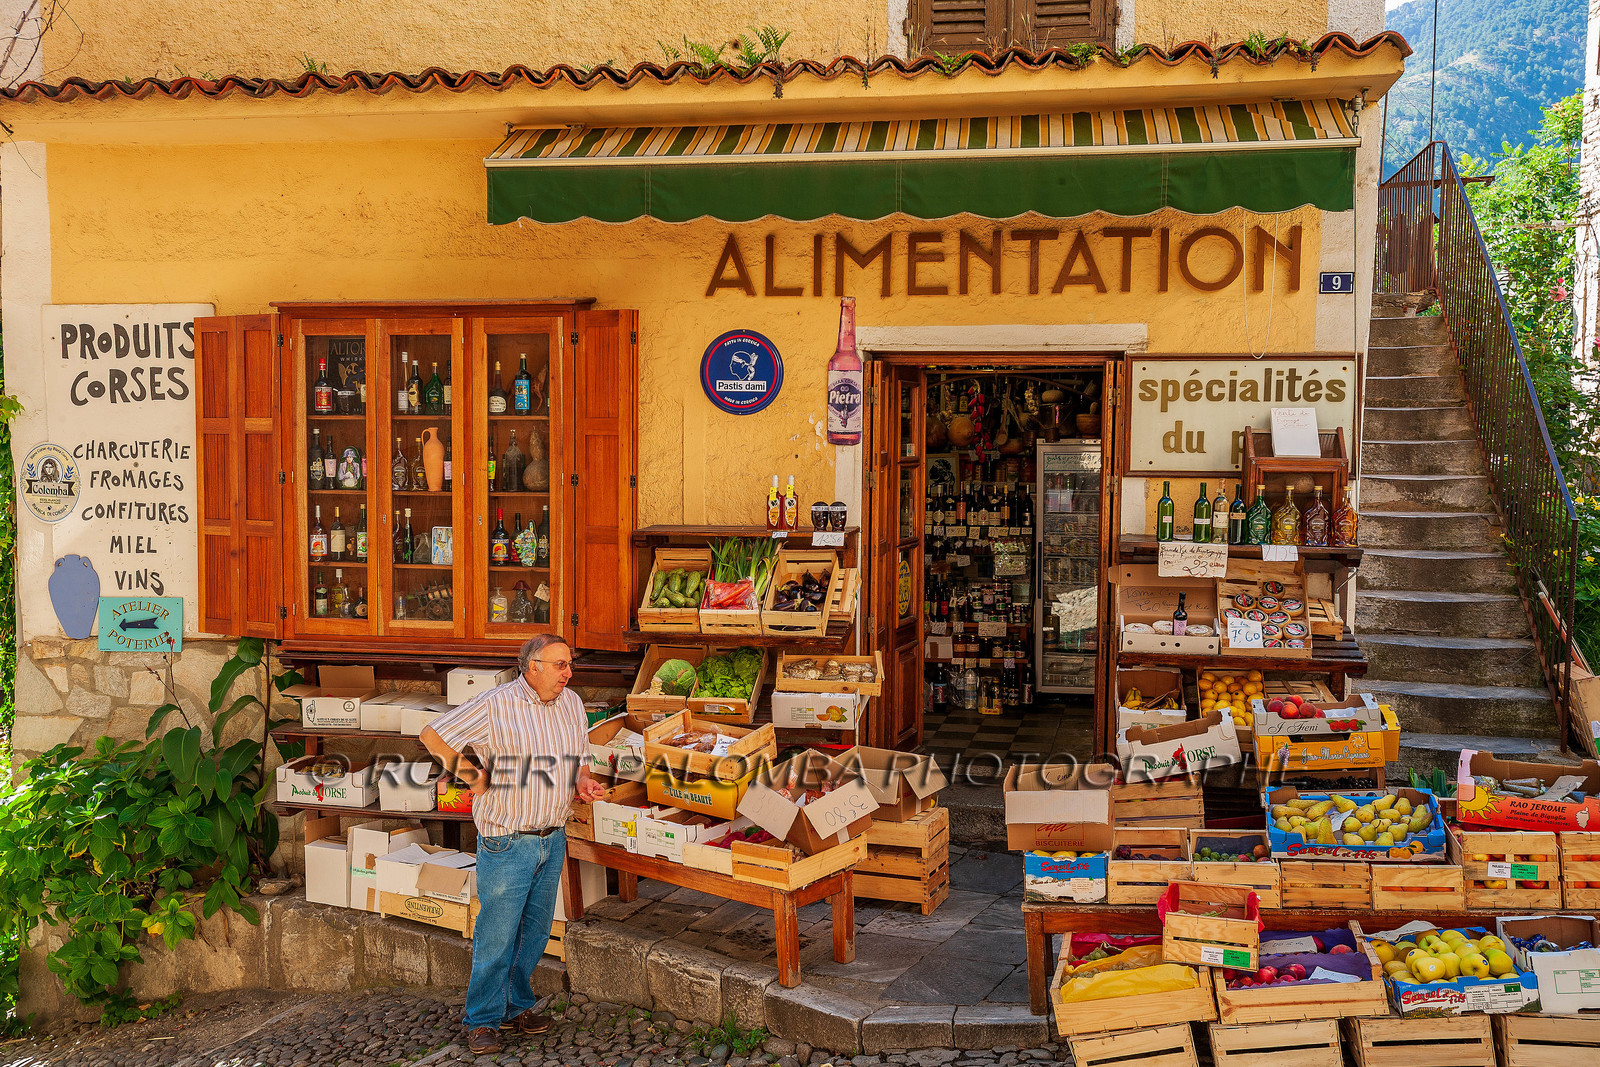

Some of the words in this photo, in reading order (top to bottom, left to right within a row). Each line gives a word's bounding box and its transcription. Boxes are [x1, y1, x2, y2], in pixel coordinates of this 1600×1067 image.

[705, 226, 1302, 297] ALIMENTATION
[1332, 276, 1341, 290] 9
[61, 322, 194, 360] PRODUITS
[71, 366, 190, 406] CORSES
[718, 381, 743, 390] Pastis
[745, 382, 765, 391] dami
[1138, 368, 1347, 412] spécialités
[829, 390, 861, 404] Pietra
[1162, 420, 1207, 454] du
[73, 438, 191, 461] CHARCUTERIE
[90, 470, 184, 491] FROMAGES
[32, 484, 68, 496] Colomba
[81, 500, 189, 523] CONFITURES
[110, 536, 157, 554] MIEL
[1183, 560, 1208, 576] 23
[114, 570, 164, 596] VINS
[112, 601, 170, 621] ATELIER
[107, 629, 168, 650] POTERIE
[1142, 759, 1169, 773] Produit
[1180, 745, 1217, 764] CORSE
[291, 784, 311, 796] Produit
[319, 787, 347, 799] CORSE
[690, 793, 712, 806] BEAUTÉ
[1530, 803, 1567, 813] JEROME
[1287, 843, 1340, 856] Samuel
[1353, 850, 1377, 859] Fils
[1041, 862, 1071, 872] Samuel
[407, 900, 441, 916] PARMENTINE
[1402, 987, 1441, 1004] Samuel
[1449, 993, 1466, 1004] Fils
